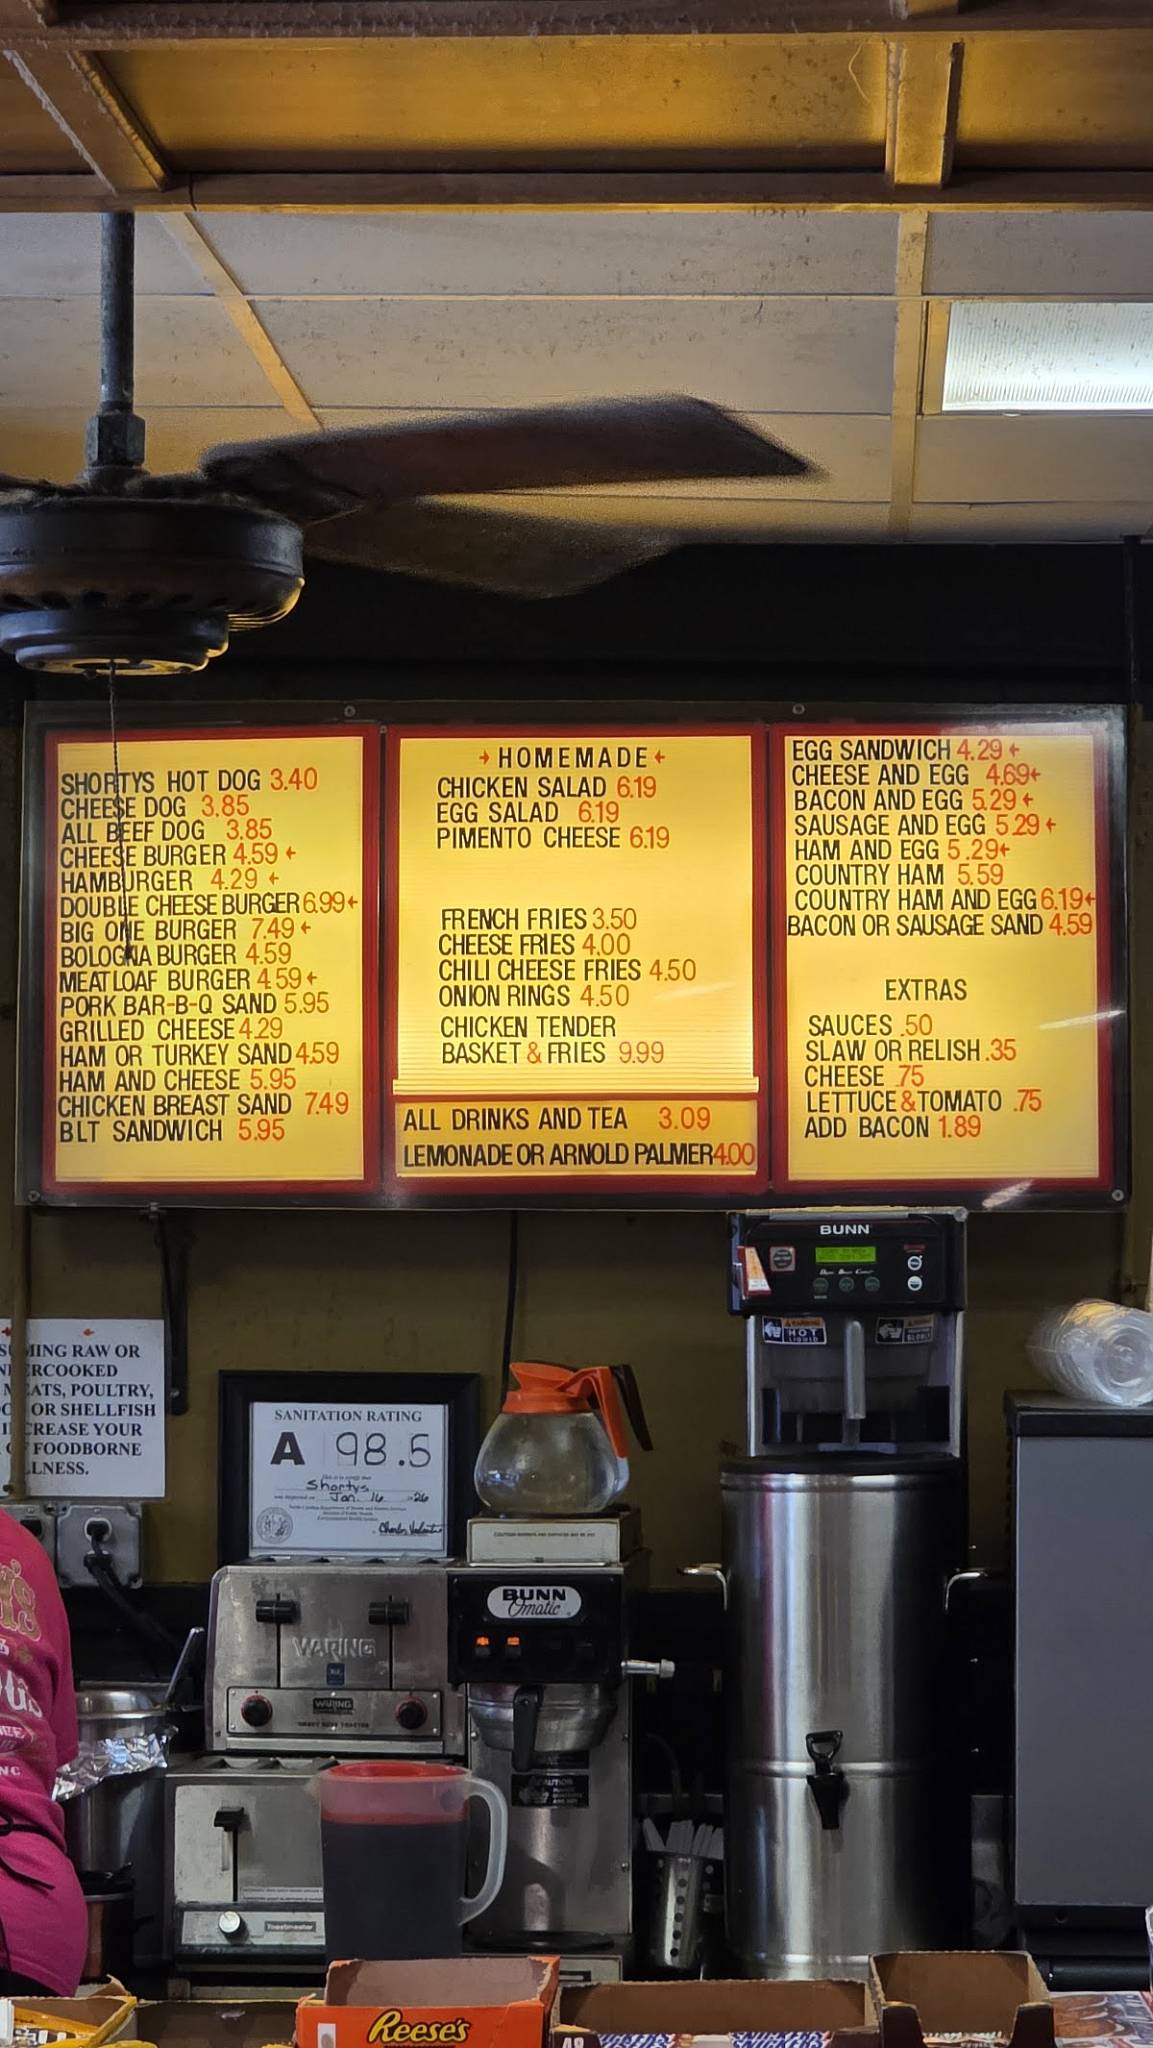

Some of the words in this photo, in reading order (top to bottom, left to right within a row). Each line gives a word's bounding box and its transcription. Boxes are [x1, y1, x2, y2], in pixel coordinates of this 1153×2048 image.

[499, 747, 648, 768] HOMEMADE
[793, 740, 832, 761] EGG
[840, 740, 950, 761] SANDWICH
[957, 739, 1002, 760] 4.29
[61, 771, 155, 795] SHORTYS
[168, 771, 209, 793] HOT
[219, 769, 261, 791] DOG
[270, 768, 317, 790] 3.40
[792, 764, 870, 786] CHEESE
[878, 764, 919, 786] AND
[930, 764, 969, 786] EGG
[986, 763, 1030, 786] 4.69
[438, 776, 528, 799] CHICKEN
[538, 776, 607, 799] SALAD
[617, 776, 656, 798] 6.19
[61, 797, 136, 819] CHEESE
[145, 796, 186, 818] DOG
[201, 795, 249, 817] 3.85
[795, 789, 865, 811] BACON
[874, 789, 916, 811] AND
[923, 789, 963, 811] EGG
[972, 789, 1016, 810] 5.29
[438, 802, 478, 824] EGG
[489, 802, 559, 824] SALAD
[579, 801, 620, 824] 6.19
[62, 823, 97, 844] ALL
[107, 821, 154, 843] BEEF
[162, 820, 205, 841] DOG
[227, 819, 272, 840] 3.85
[795, 814, 889, 836] SAUSAGE
[898, 814, 939, 836] AND
[947, 813, 985, 835] EGG
[438, 827, 531, 849] PIMENTO
[544, 827, 621, 849] CHEESE
[630, 826, 670, 849] 6.19
[61, 846, 136, 869] CHEESE
[144, 845, 226, 866] BURGER
[233, 843, 278, 865] 4.59
[796, 840, 840, 861] HAM
[850, 840, 891, 861] AND
[901, 840, 939, 861] EGG
[211, 868, 258, 890] 4.29
[796, 864, 890, 886] COUNTRY
[898, 864, 944, 886] HAM
[958, 863, 1003, 886] 5.59
[61, 897, 138, 919] DOUBLE
[146, 895, 217, 917] CHEESE
[222, 893, 299, 915] BURGER
[304, 891, 345, 913] 6.99
[795, 889, 890, 911] COUNTRY
[899, 889, 943, 911] HAM
[951, 889, 990, 911] AND
[998, 889, 1036, 911] EGG
[1041, 887, 1083, 910] 6.19
[442, 908, 519, 930] FRENCH
[528, 908, 587, 930] FRIES
[592, 908, 637, 930] 3.50
[788, 915, 855, 936] BACON
[863, 915, 890, 936] OR
[897, 915, 984, 936] SAUSAGE
[991, 915, 1043, 936] SAND
[1049, 913, 1092, 935] 4.59
[61, 922, 93, 944] BIG
[156, 920, 236, 941] BURGER
[252, 918, 294, 940] 7.49
[158, 944, 236, 966] BURGER
[246, 943, 291, 965] 4.59
[438, 934, 512, 956] CHEESE
[520, 934, 575, 956] FRIES
[582, 933, 631, 956] 4.00
[169, 969, 250, 991] BURGER
[439, 959, 490, 981] CHILI
[497, 959, 576, 981] CHEESE
[584, 959, 642, 981] FRIES
[650, 959, 697, 981] 4.50
[439, 985, 500, 1008] ONION
[508, 985, 571, 1008] RINGS
[580, 984, 630, 1007] 4.50
[886, 979, 967, 1001] EXTRAS
[61, 996, 116, 1017] PORK
[124, 995, 212, 1016] BAR-B-Q
[223, 993, 276, 1015] SAND
[284, 992, 329, 1014] 5.95
[61, 1020, 144, 1042] GRILLED
[158, 1019, 235, 1041] CHEESE
[239, 1017, 283, 1039] 4.29
[441, 1016, 528, 1038] CHICKEN
[537, 1016, 616, 1038] TENDER
[809, 1015, 892, 1037] SAUCES
[901, 1014, 933, 1037] .50
[61, 1046, 105, 1068] HAM
[116, 1045, 142, 1067] OR
[153, 1044, 229, 1066] TURKEY
[238, 1043, 291, 1065] SAND
[296, 1042, 339, 1064] 4.59
[443, 1042, 522, 1064] BASKET
[548, 1042, 606, 1064] FRIES
[619, 1041, 664, 1064] 9.99
[806, 1039, 867, 1062] SLAW
[875, 1039, 902, 1062] OR
[909, 1039, 980, 1062] RELISH
[985, 1038, 1016, 1061] .35
[60, 1071, 104, 1093] HAM
[115, 1070, 156, 1091] AND
[164, 1069, 240, 1090] CHEESE
[251, 1068, 296, 1090] 5.95
[805, 1065, 884, 1088] CHEESE
[58, 1096, 145, 1118] CHICKEN
[153, 1095, 230, 1116] BREAST
[238, 1094, 291, 1115] SAND
[305, 1092, 349, 1115] 7.49
[807, 1090, 896, 1113] LETTUCE
[917, 1090, 1002, 1112] TOMATO
[1014, 1088, 1042, 1112] .75
[404, 1108, 441, 1131] ALL
[453, 1108, 529, 1131] DRINKS
[538, 1108, 581, 1131] AND
[588, 1108, 628, 1131] TEA
[658, 1106, 710, 1131] 3.09
[805, 1115, 847, 1138] ADD
[859, 1115, 929, 1138] BACON
[938, 1114, 981, 1138] 1.89
[113, 1120, 222, 1142] SANDWICH
[239, 1119, 285, 1141] 5.95
[404, 1144, 513, 1167] LEMONADE
[517, 1144, 544, 1167] OR
[550, 1144, 629, 1167] ARNOLD
[635, 1144, 714, 1167] PALMER
[713, 1142, 754, 1167] 4.00
[820, 1225, 870, 1235] BUNN
[72, 1345, 110, 1358] RAW
[115, 1345, 140, 1358] OR
[71, 1384, 154, 1399] POULTRY,
[31, 1403, 56, 1416] OR
[61, 1403, 156, 1416] SHELLFISH
[274, 1410, 362, 1421] SANITATION
[367, 1411, 422, 1422] RATING
[94, 1423, 143, 1437] YOUR
[34, 1443, 142, 1456] FOODBORNE
[271, 1432, 305, 1465] A
[336, 1432, 431, 1468] 98.5
[503, 1589, 566, 1601] BUNN
[292, 1637, 376, 1661] WARING
[368, 2009, 471, 2042] Reese's
